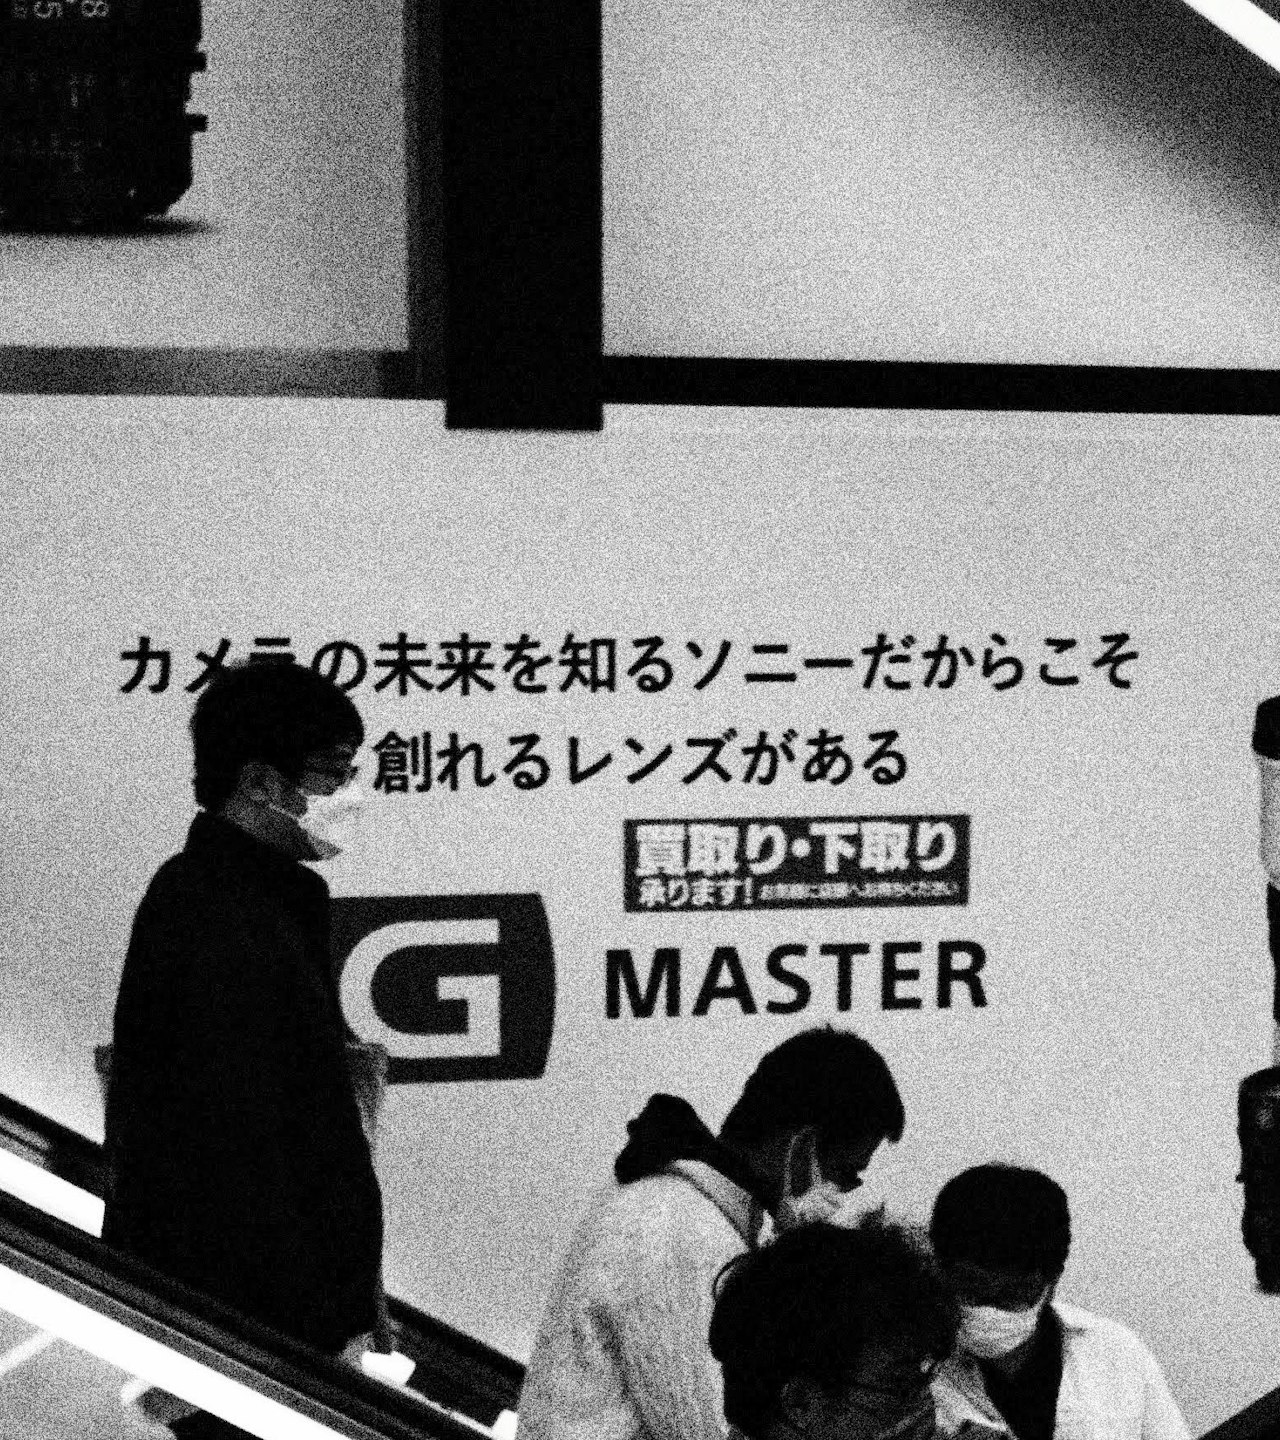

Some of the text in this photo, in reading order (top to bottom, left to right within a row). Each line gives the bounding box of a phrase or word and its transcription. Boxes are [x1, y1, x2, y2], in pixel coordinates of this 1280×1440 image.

[371, 726, 909, 794] 創れるレンズがある
[636, 820, 957, 876] 買取り・下取り
[338, 917, 502, 1060] G
[603, 938, 988, 1019] MASTER
